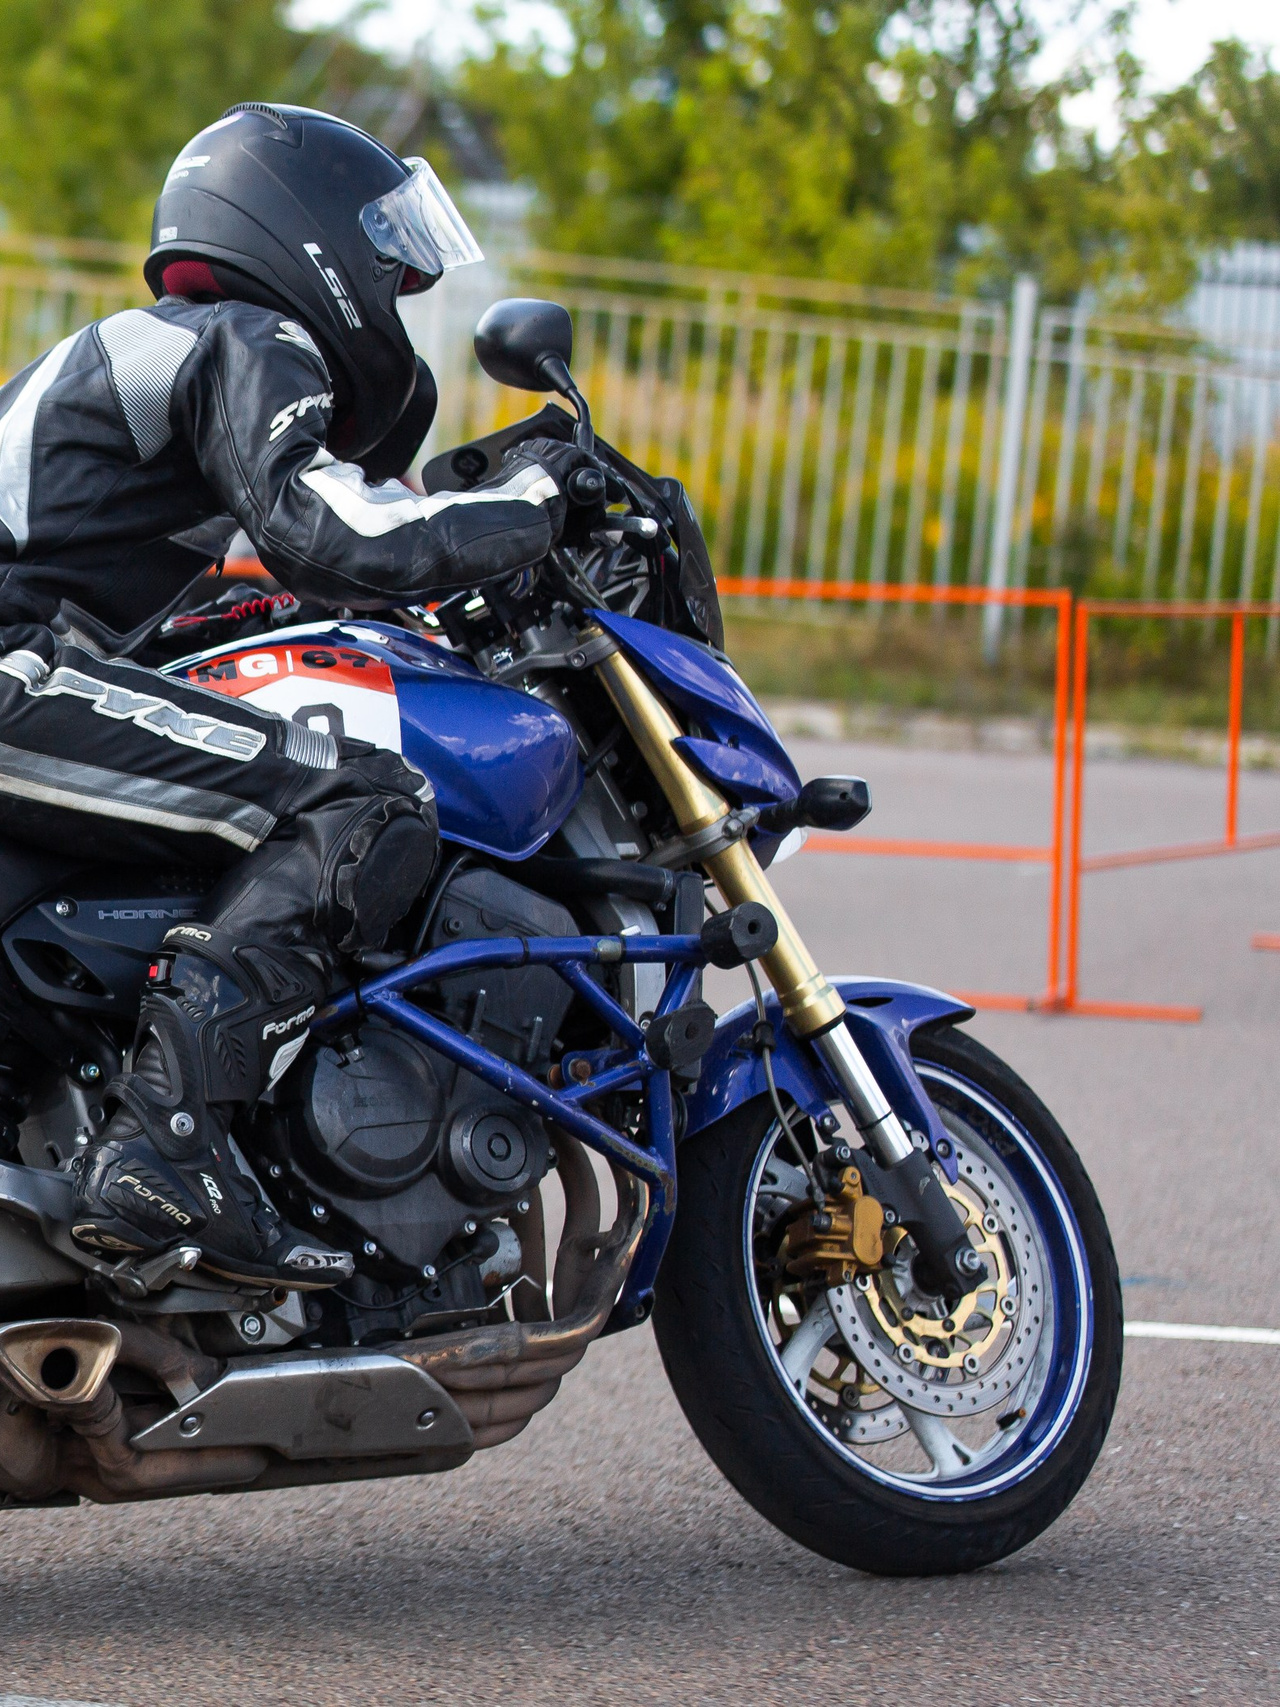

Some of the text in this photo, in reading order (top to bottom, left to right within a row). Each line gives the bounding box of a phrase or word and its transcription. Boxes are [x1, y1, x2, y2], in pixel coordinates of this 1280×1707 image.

[303, 242, 362, 330] LS2
[268, 392, 335, 442] SPYK
[98, 907, 199, 920] HORNE
[262, 1004, 317, 1041] Forma
[117, 1174, 192, 1227] Forma
[209, 1198, 222, 1215] PRO
